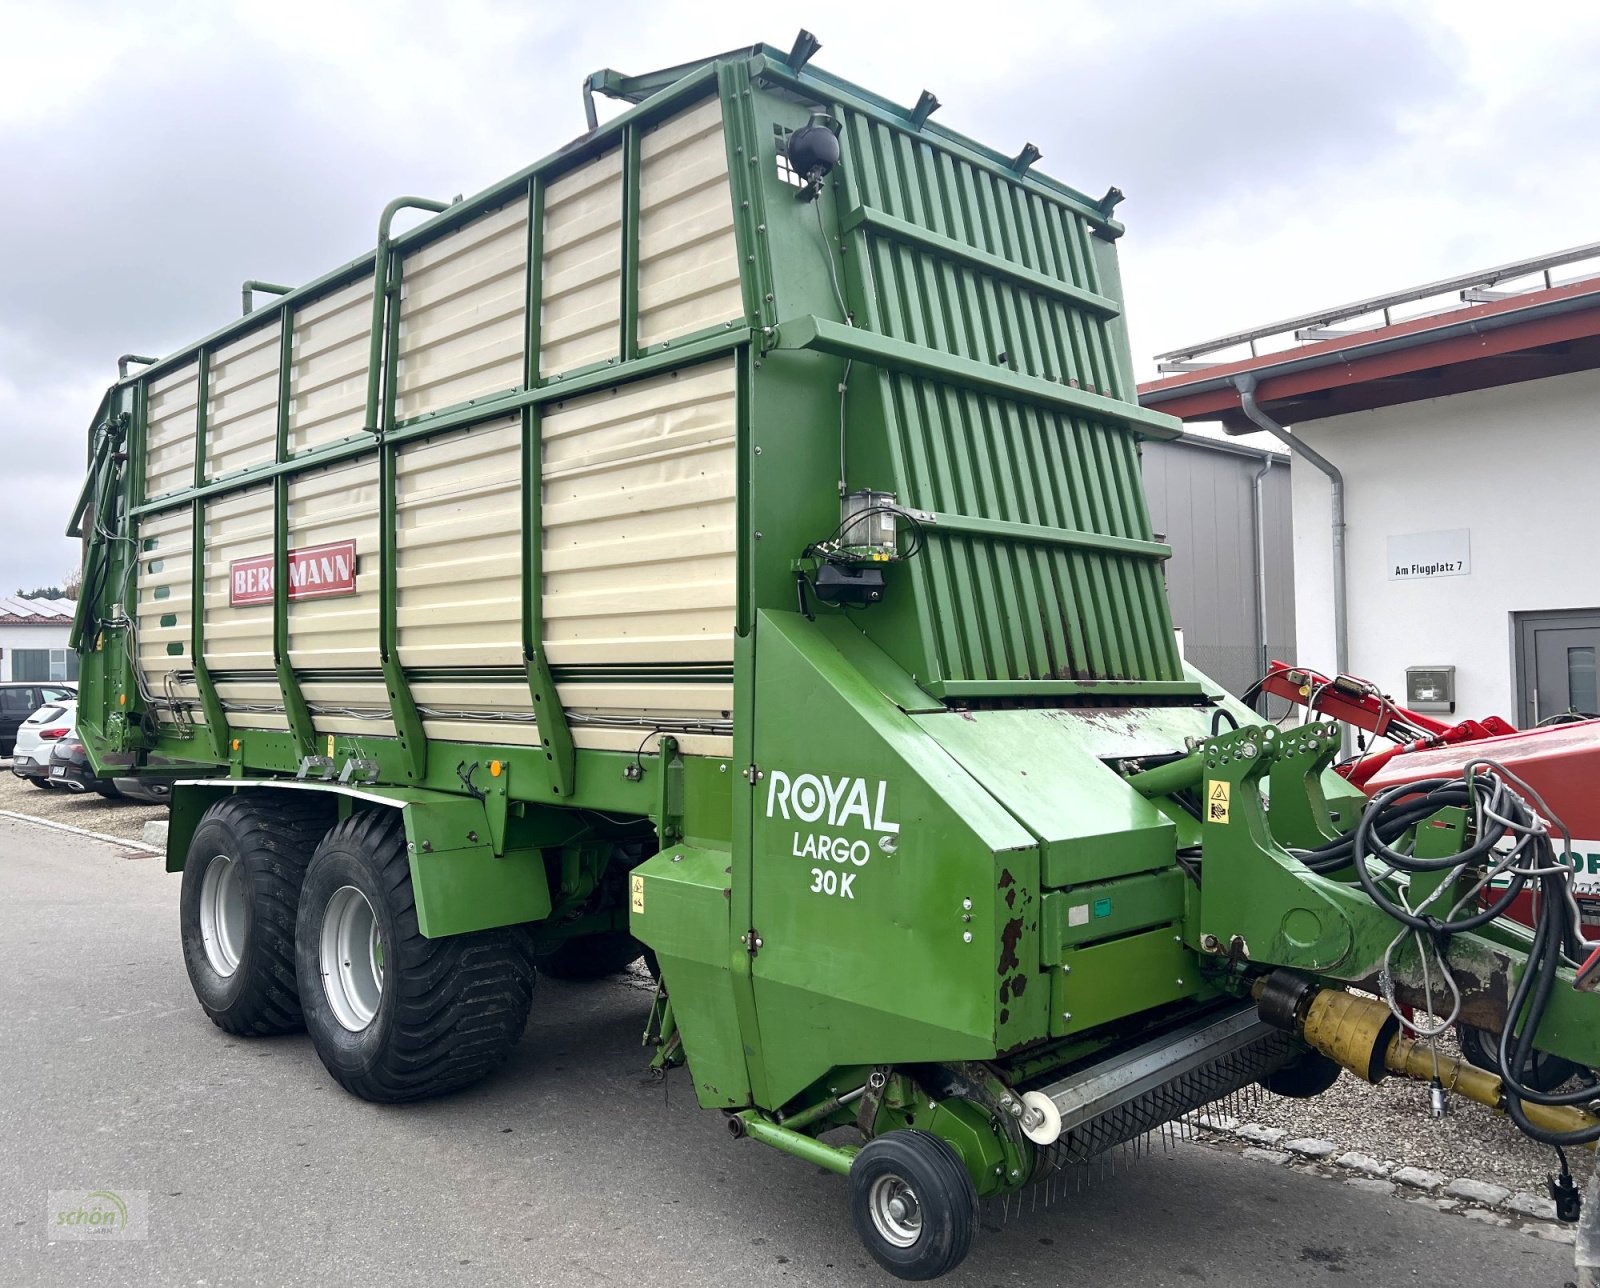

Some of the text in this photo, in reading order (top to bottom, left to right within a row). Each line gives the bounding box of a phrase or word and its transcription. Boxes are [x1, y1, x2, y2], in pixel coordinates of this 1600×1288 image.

[1395, 560, 1463, 576] Am Flugplatz 7
[766, 770, 900, 834] ROYAL
[792, 831, 870, 867] LARGO
